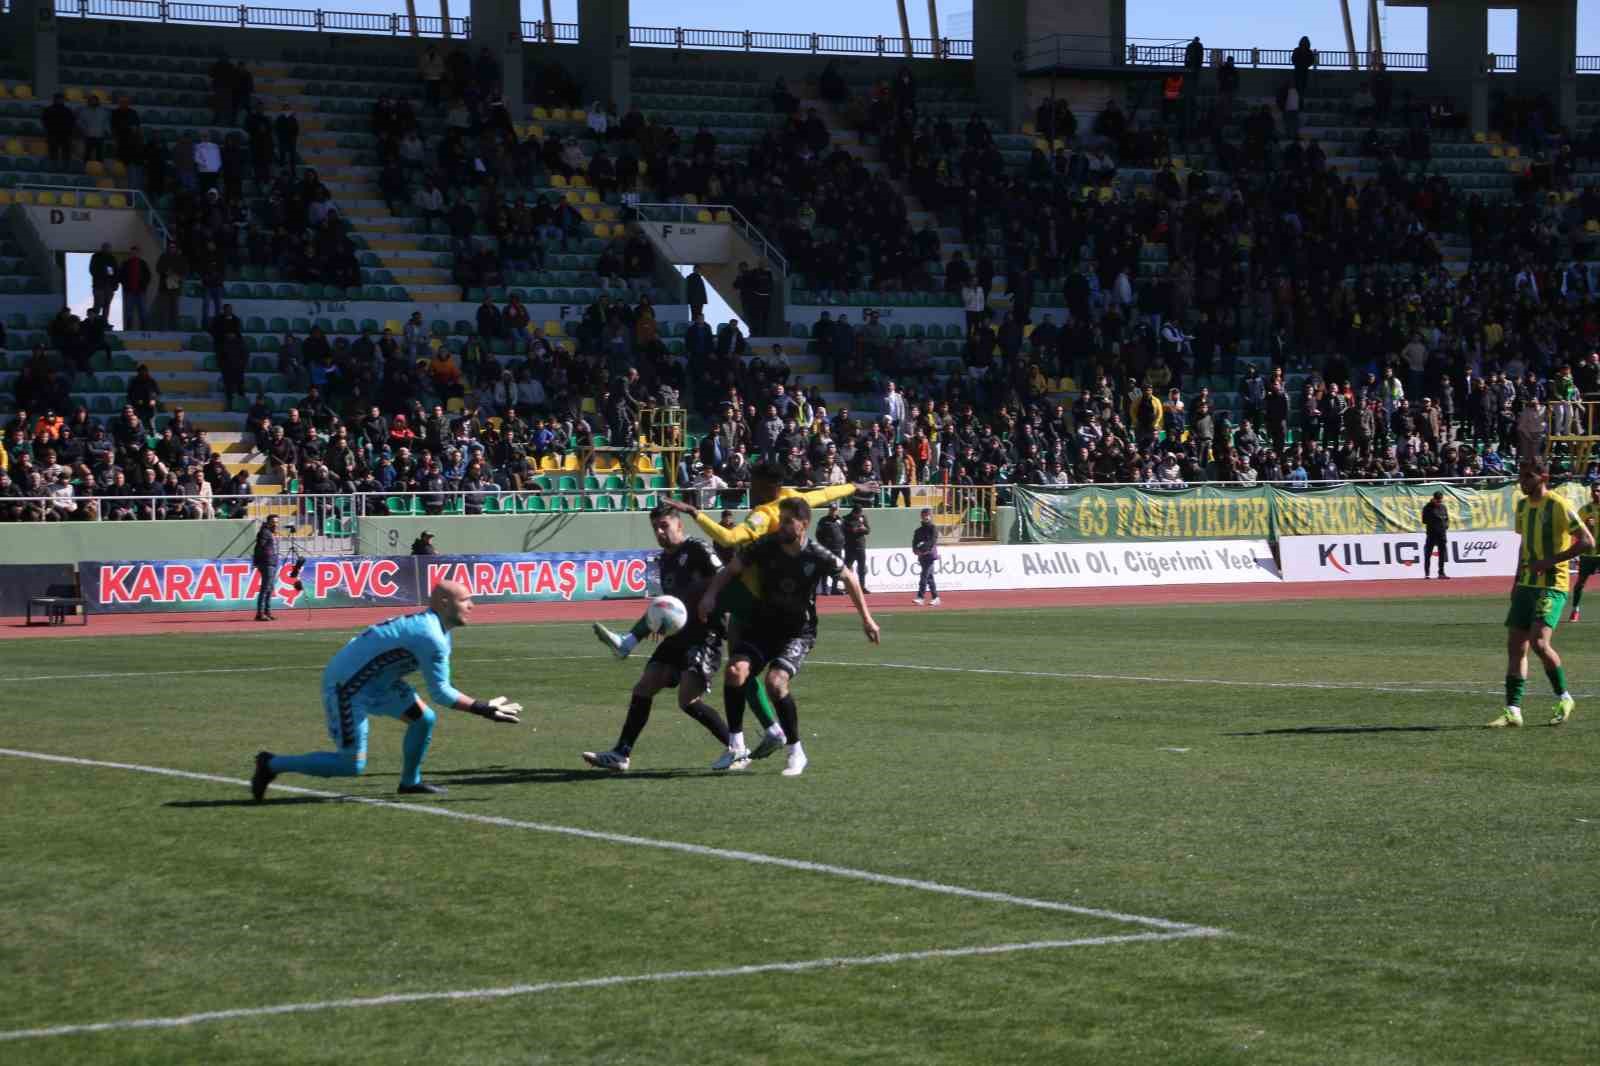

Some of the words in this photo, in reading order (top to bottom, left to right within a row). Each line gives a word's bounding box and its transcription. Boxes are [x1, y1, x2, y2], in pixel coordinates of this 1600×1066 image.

[1078, 495, 1109, 537] 63
[387, 528, 399, 547] 9
[314, 559, 400, 599] PVC
[427, 560, 578, 601] KARATAŞ
[584, 559, 647, 593] PVC
[1022, 550, 1081, 576] Akıllı
[1085, 551, 1118, 575] Ol,
[1124, 549, 1212, 578] Ciğerimi
